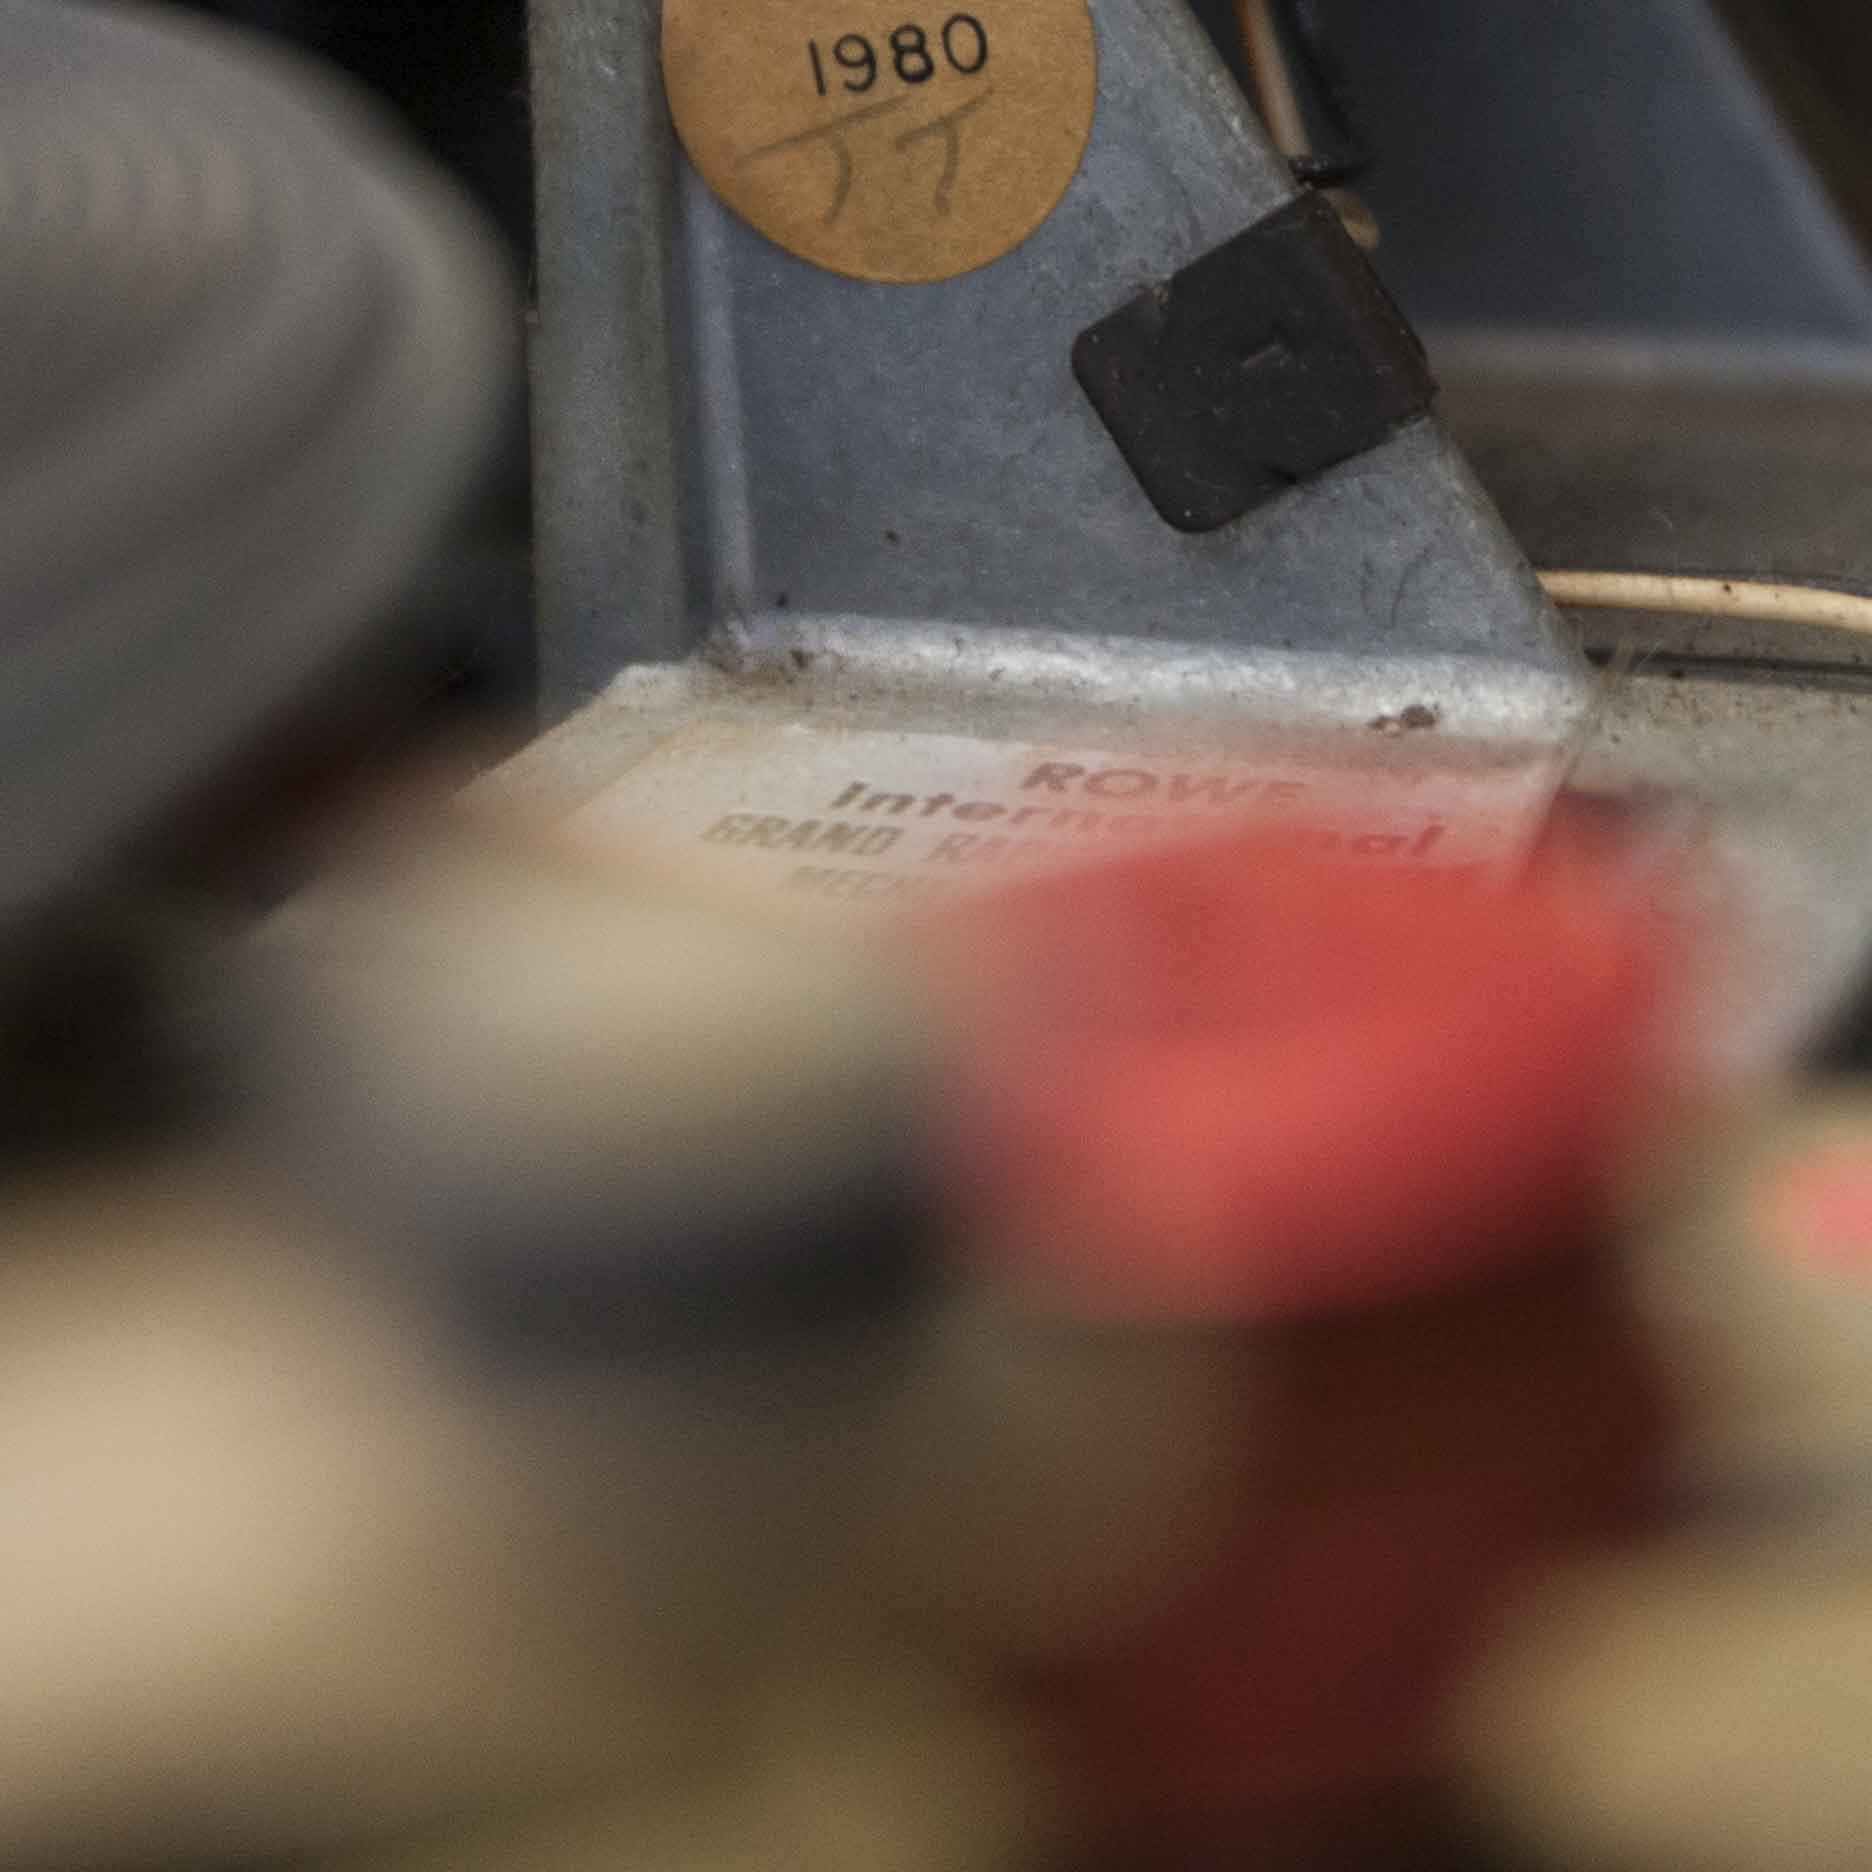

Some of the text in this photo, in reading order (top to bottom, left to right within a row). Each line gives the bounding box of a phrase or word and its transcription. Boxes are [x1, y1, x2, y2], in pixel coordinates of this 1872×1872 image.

[807, 12, 988, 97] 1980
[1018, 761, 1308, 806] ROWE
[700, 813, 906, 856] GRAND
